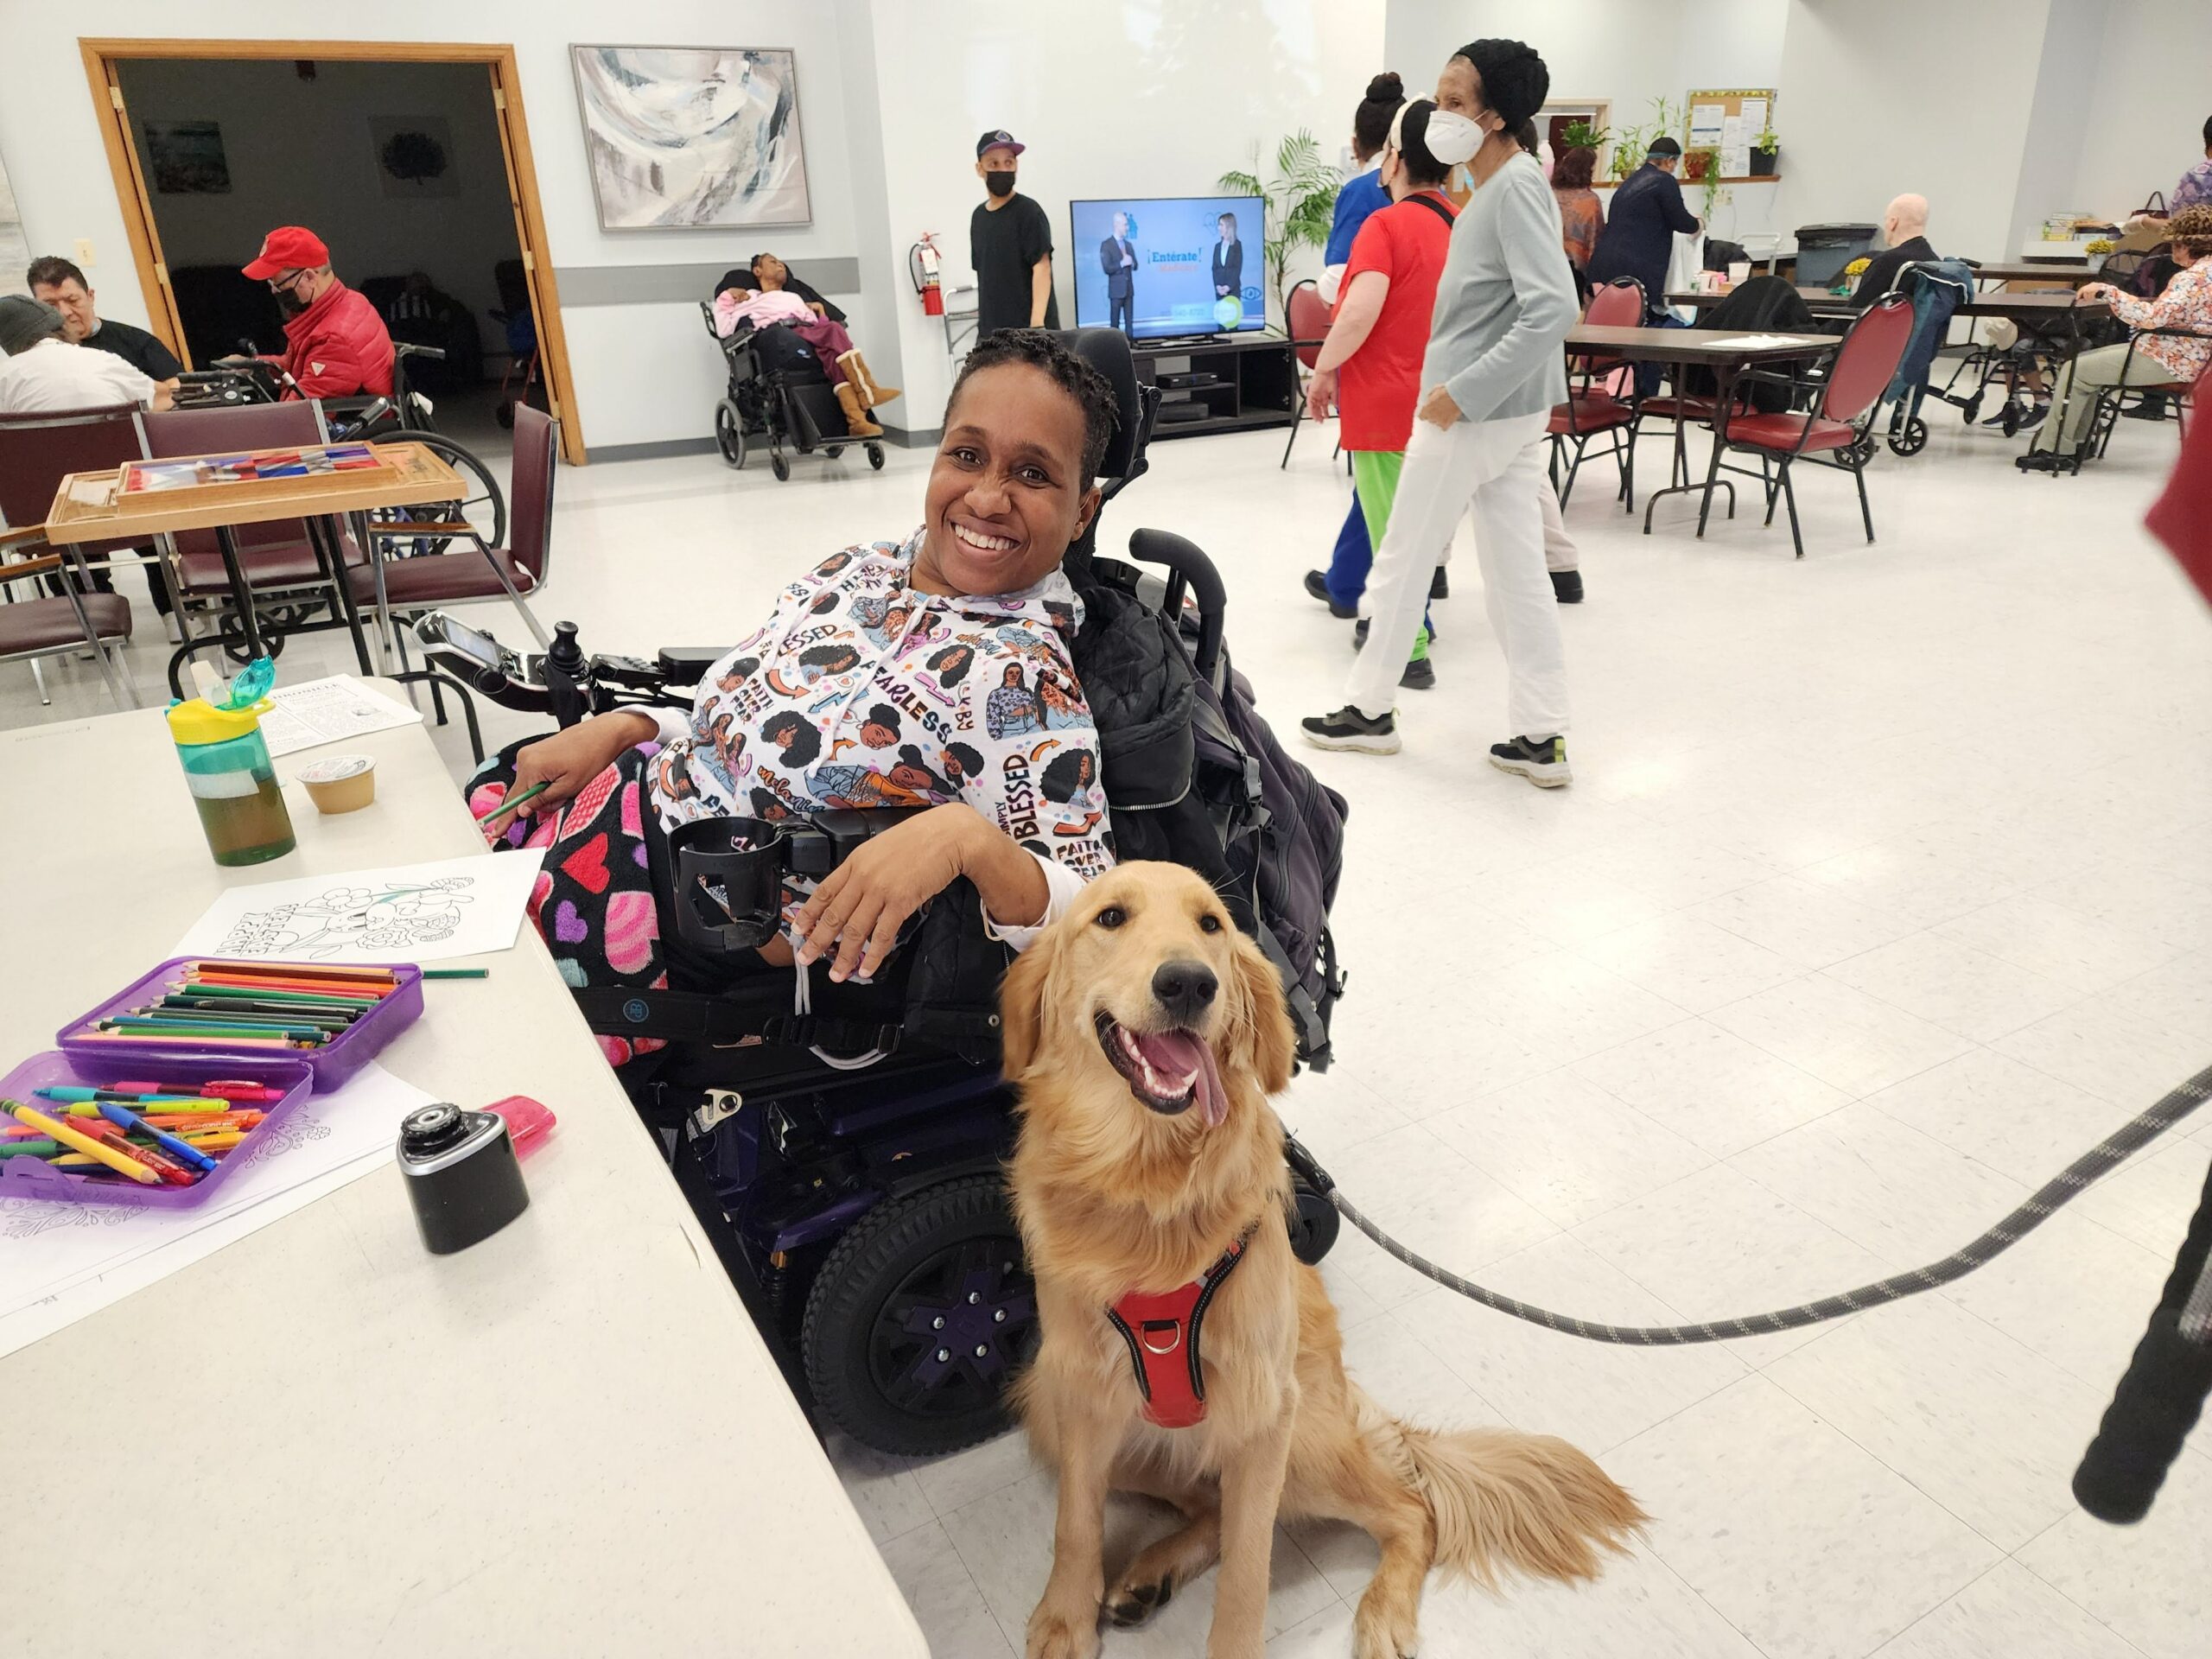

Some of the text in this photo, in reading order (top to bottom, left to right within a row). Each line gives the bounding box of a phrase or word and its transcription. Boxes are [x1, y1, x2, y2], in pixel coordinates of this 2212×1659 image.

[1147, 247, 1202, 264] ¡Entérate!
[739, 689, 761, 716] OVER
[747, 677, 774, 710] FAITH
[729, 695, 752, 725] FEAR
[1003, 754, 1040, 841] BLESSED
